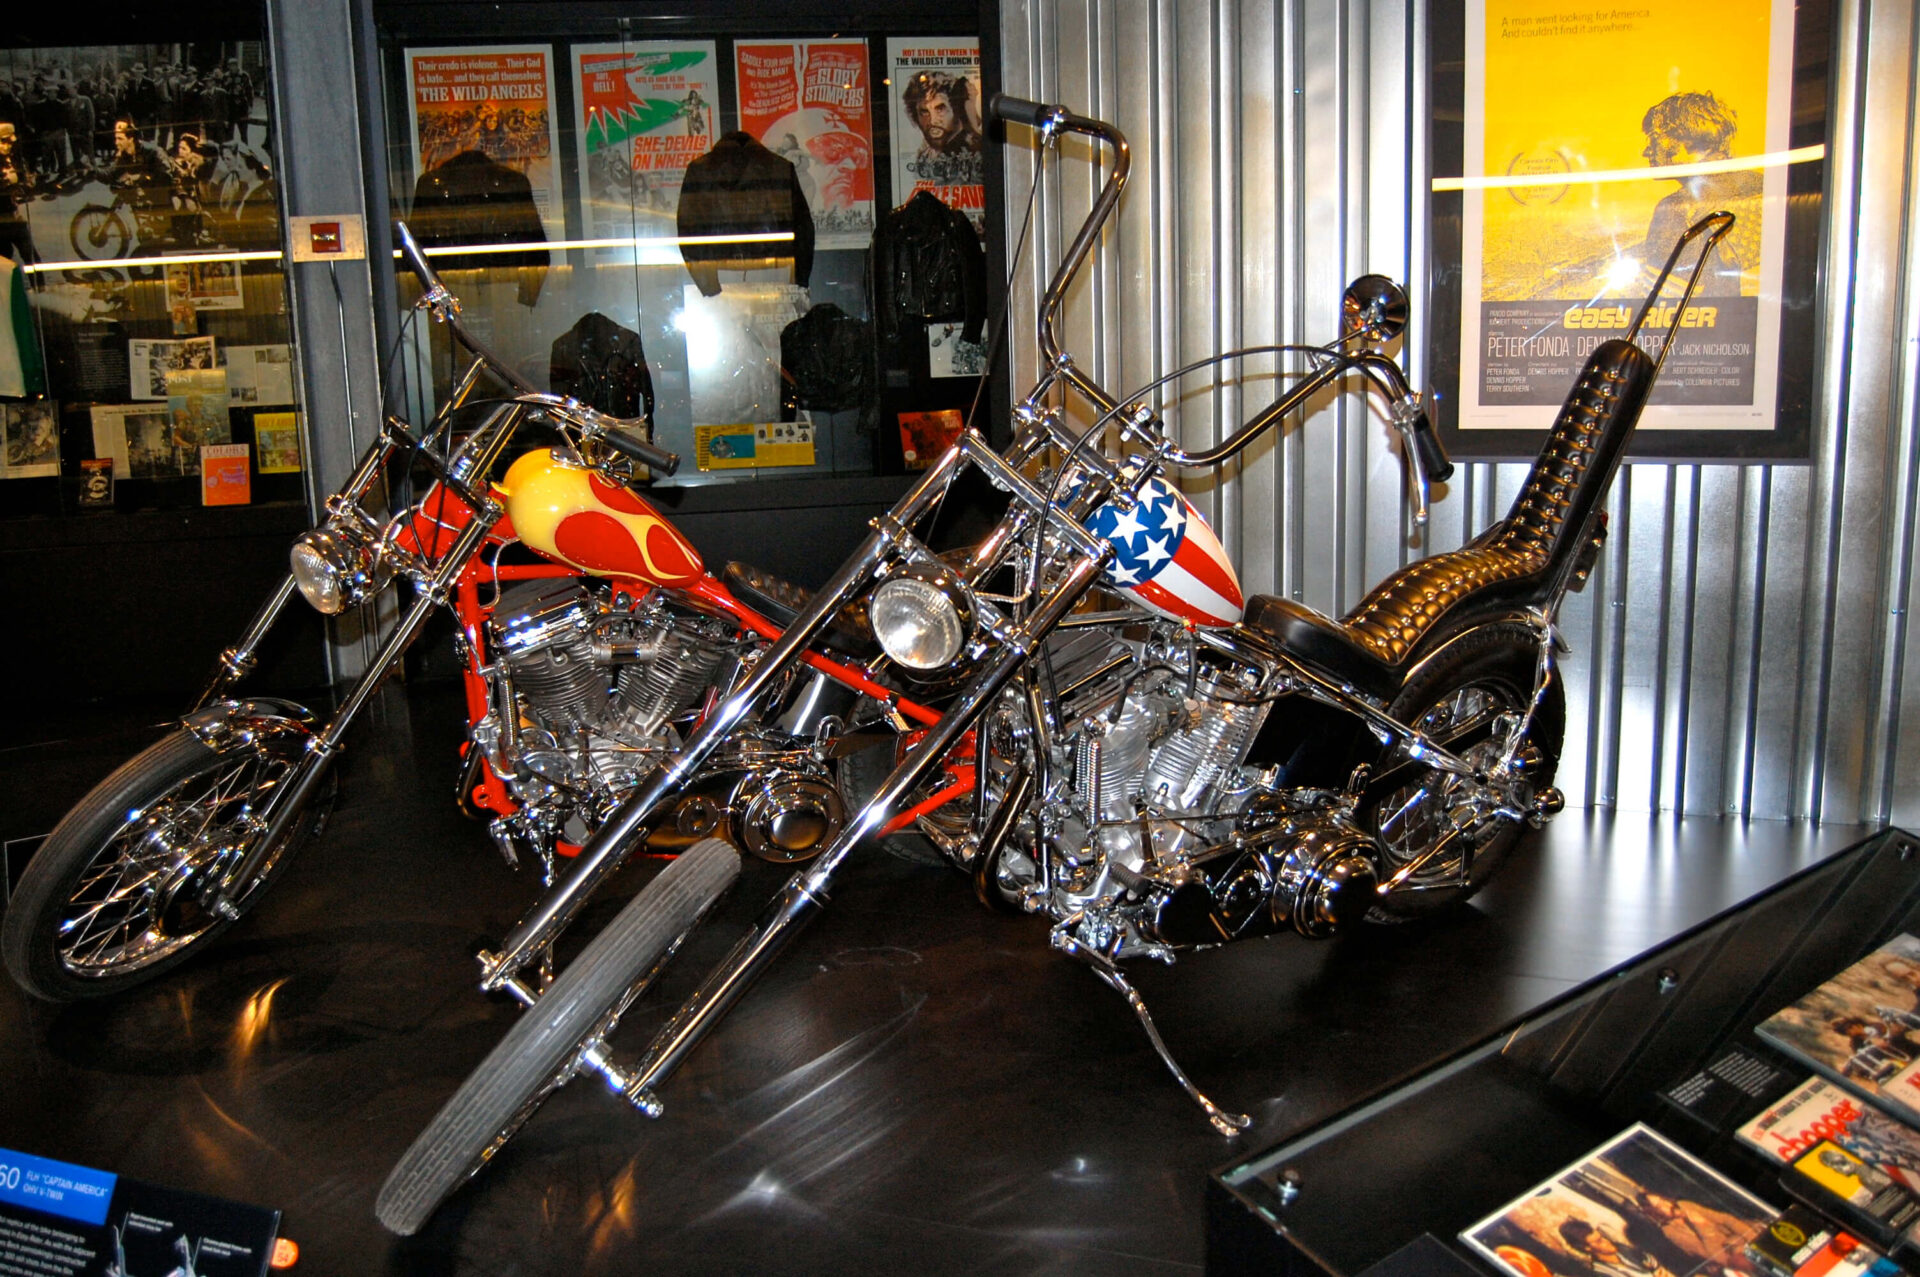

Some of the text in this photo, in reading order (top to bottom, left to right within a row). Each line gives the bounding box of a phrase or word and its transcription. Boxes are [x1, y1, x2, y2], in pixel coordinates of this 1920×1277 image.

[1501, 17, 1509, 27] A
[1512, 17, 1532, 26] man
[1535, 14, 1557, 25] went
[1559, 12, 1593, 24] looking
[1595, 10, 1609, 21] for
[1501, 29, 1520, 39] And
[1521, 26, 1558, 37] couldn't
[1560, 24, 1578, 35] find
[1580, 23, 1586, 33] it
[418, 60, 437, 71] Their
[438, 60, 459, 71] credo
[460, 60, 468, 70] is
[506, 58, 525, 69] Their
[526, 57, 541, 68] God
[896, 57, 909, 66] THE
[911, 57, 944, 66] WILDEST
[947, 57, 972, 65] BUNCH
[418, 75, 426, 84] is
[454, 73, 468, 83] and
[469, 72, 485, 85] they
[486, 71, 500, 82] call
[501, 70, 542, 82] themselves
[806, 76, 817, 87] THE
[817, 68, 861, 88] GLORY
[452, 84, 489, 101] WILD
[805, 85, 865, 108] STOMPERS
[633, 135, 709, 153] SHE-DEVILS
[631, 154, 653, 171] ON
[1563, 307, 1632, 329] easy
[1488, 336, 1526, 357] PETER
[1530, 336, 1570, 357] FONDA
[1680, 343, 1701, 356] JACK
[1702, 343, 1750, 356] NICHOLSON
[26, 1170, 41, 1182] FLH
[23, 1183, 39, 1195] OHV
